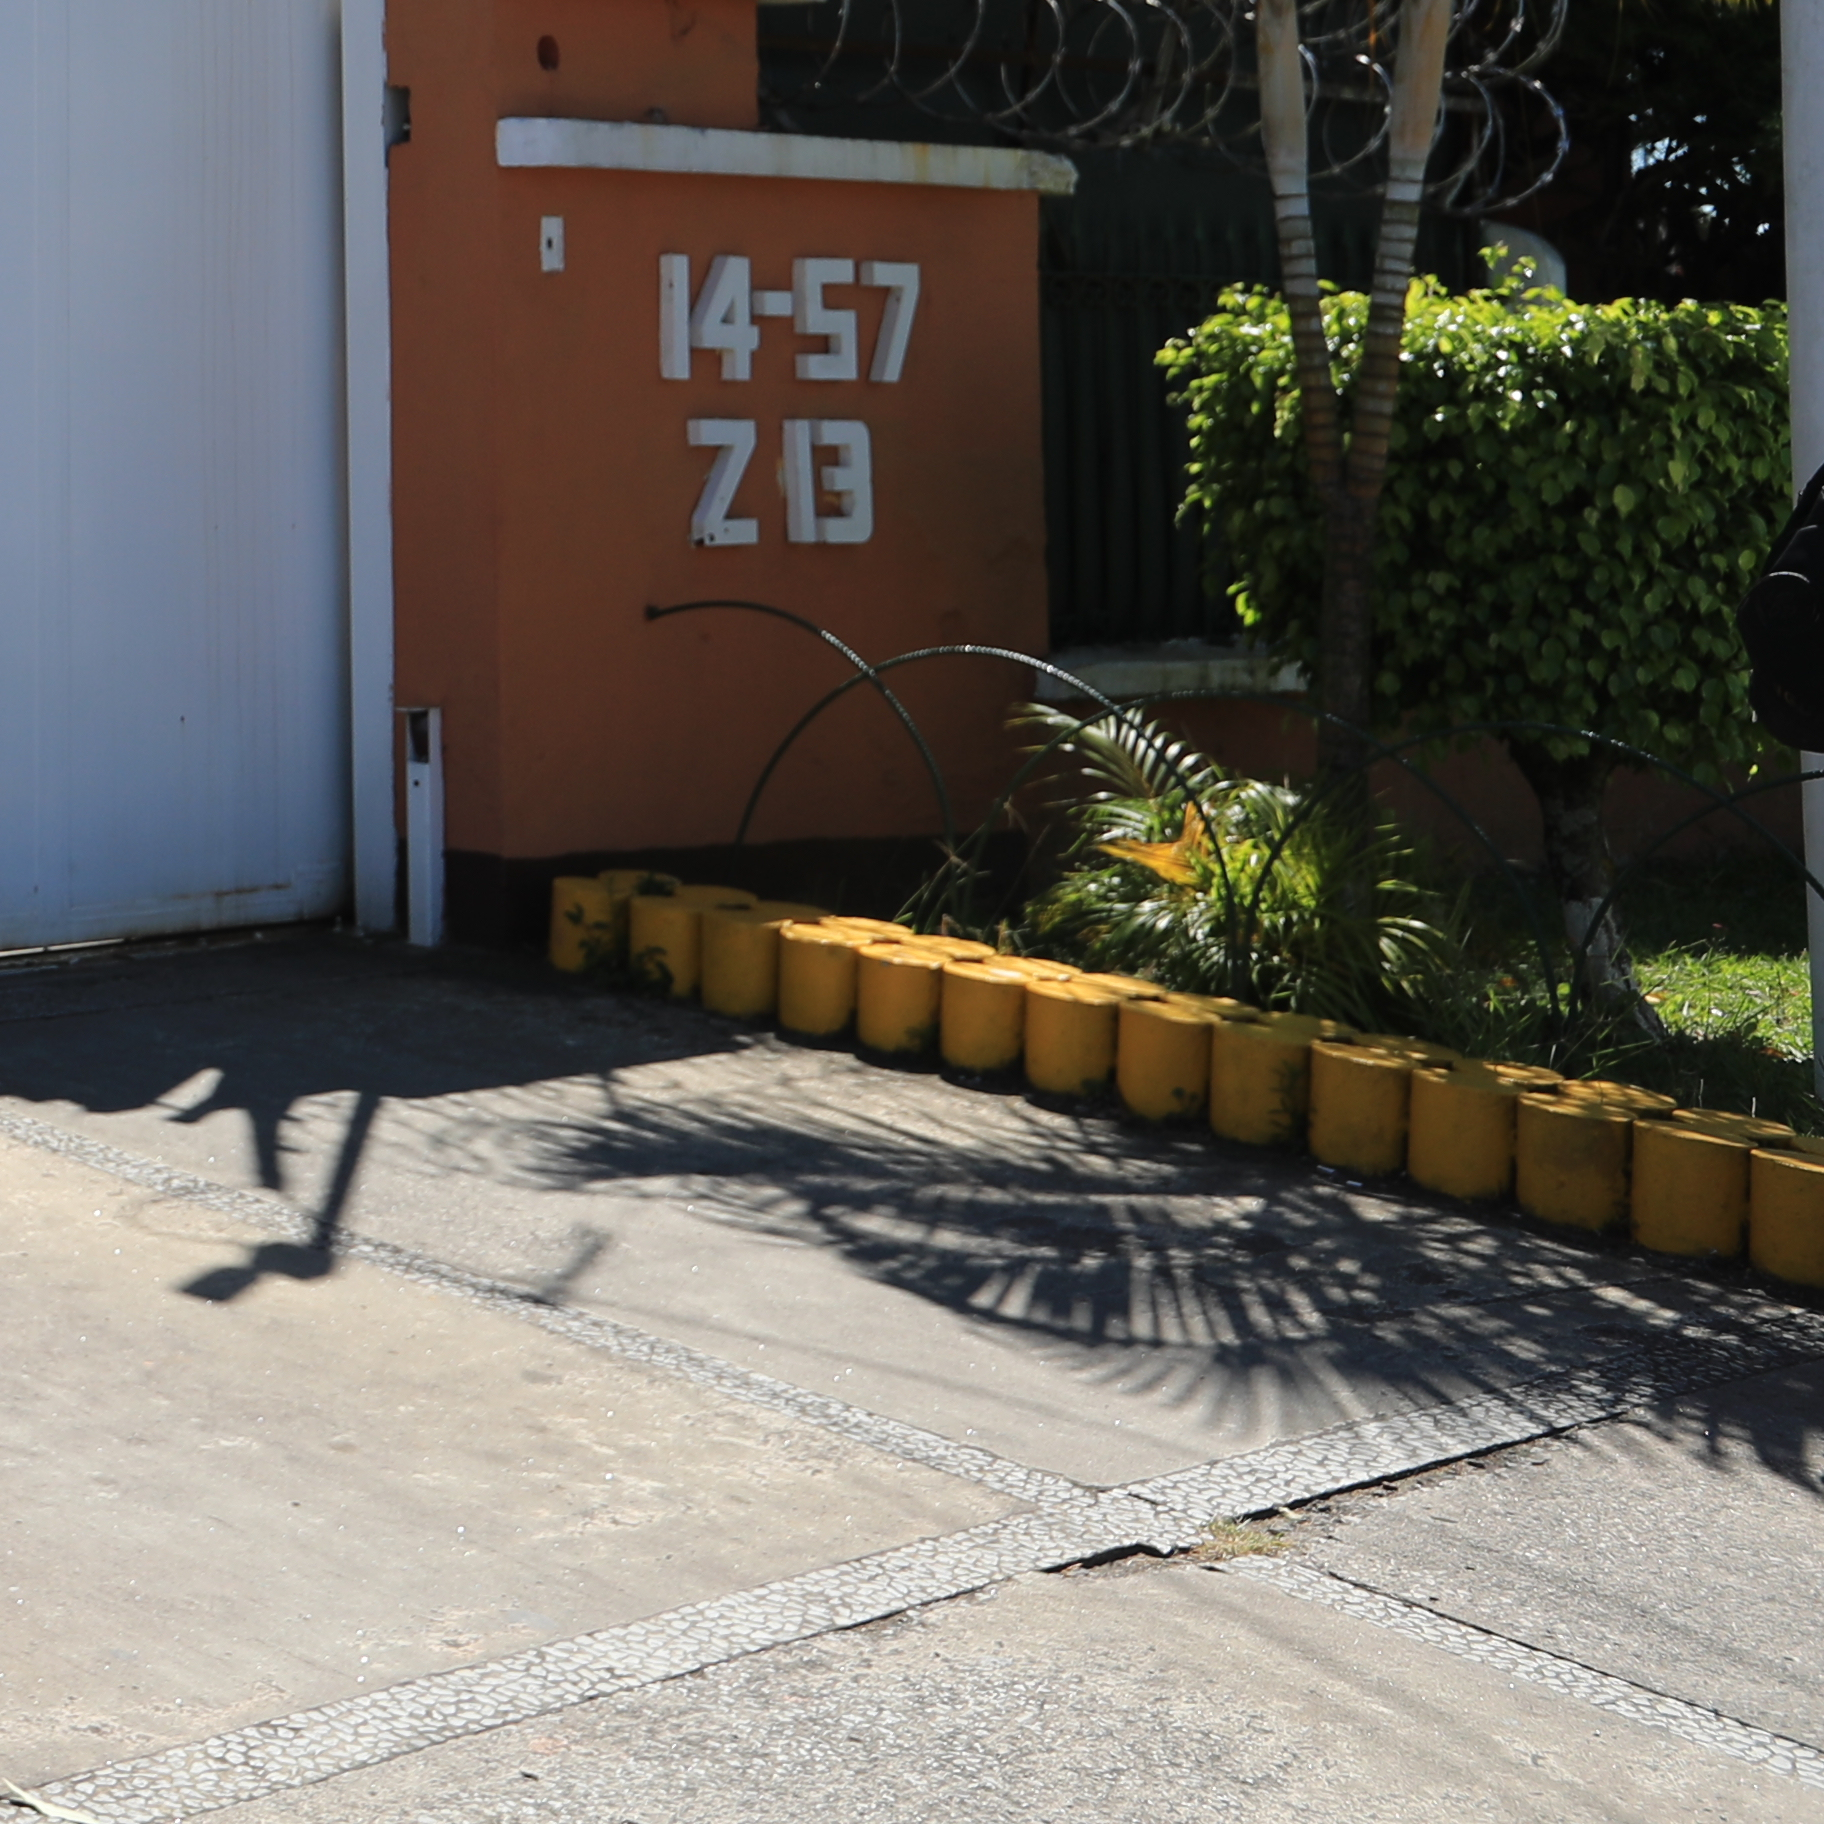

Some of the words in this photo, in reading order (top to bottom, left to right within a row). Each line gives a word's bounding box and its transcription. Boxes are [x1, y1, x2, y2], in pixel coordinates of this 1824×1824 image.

[659, 252, 921, 383] 14-57
[687, 418, 758, 546] Z
[783, 418, 875, 544] 13
